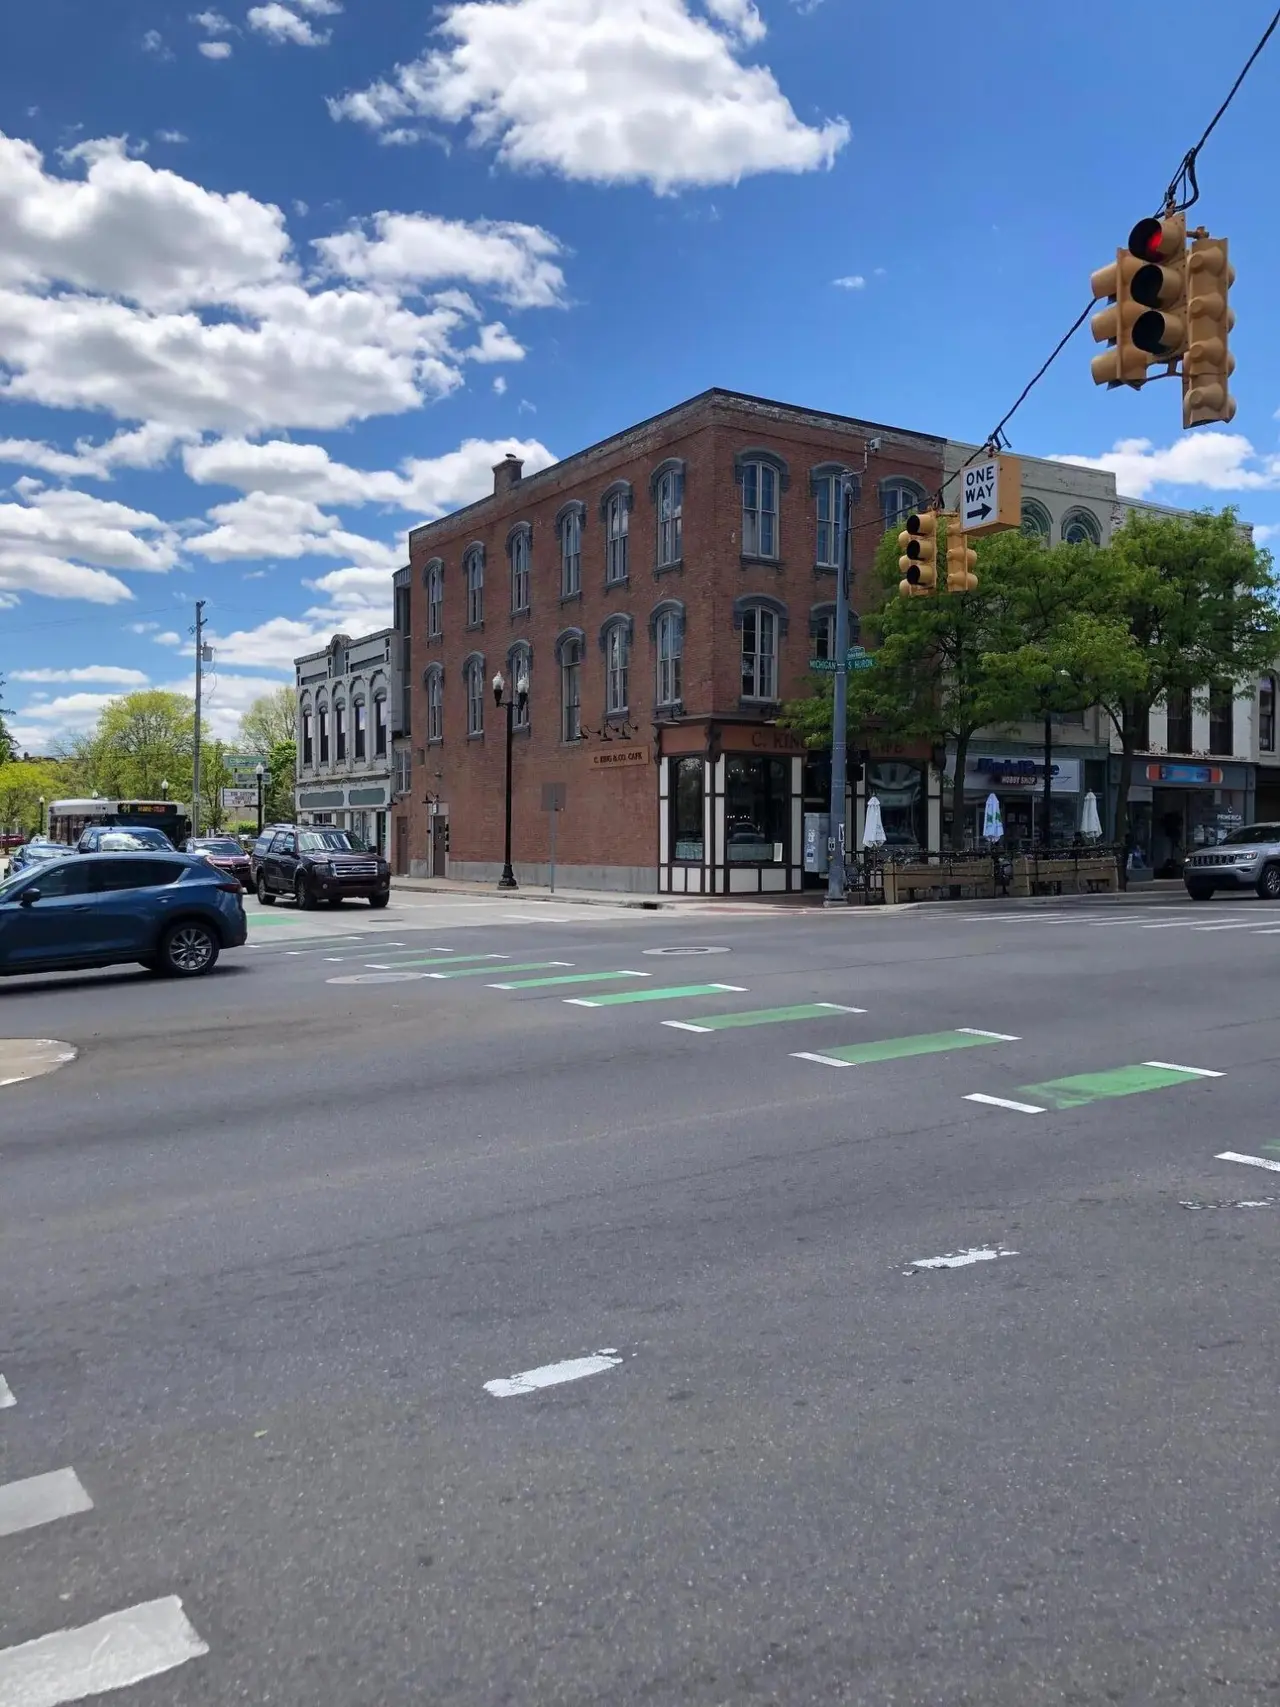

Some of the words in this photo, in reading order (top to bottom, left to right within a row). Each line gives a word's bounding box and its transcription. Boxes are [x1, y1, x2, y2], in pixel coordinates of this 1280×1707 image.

[966, 466, 994, 486] ONE
[965, 482, 995, 504] WAY
[809, 659, 837, 670] MICHIGAN
[854, 659, 873, 669] HURON
[1001, 775, 1020, 785] HOBBY
[1020, 776, 1036, 786] SHOP
